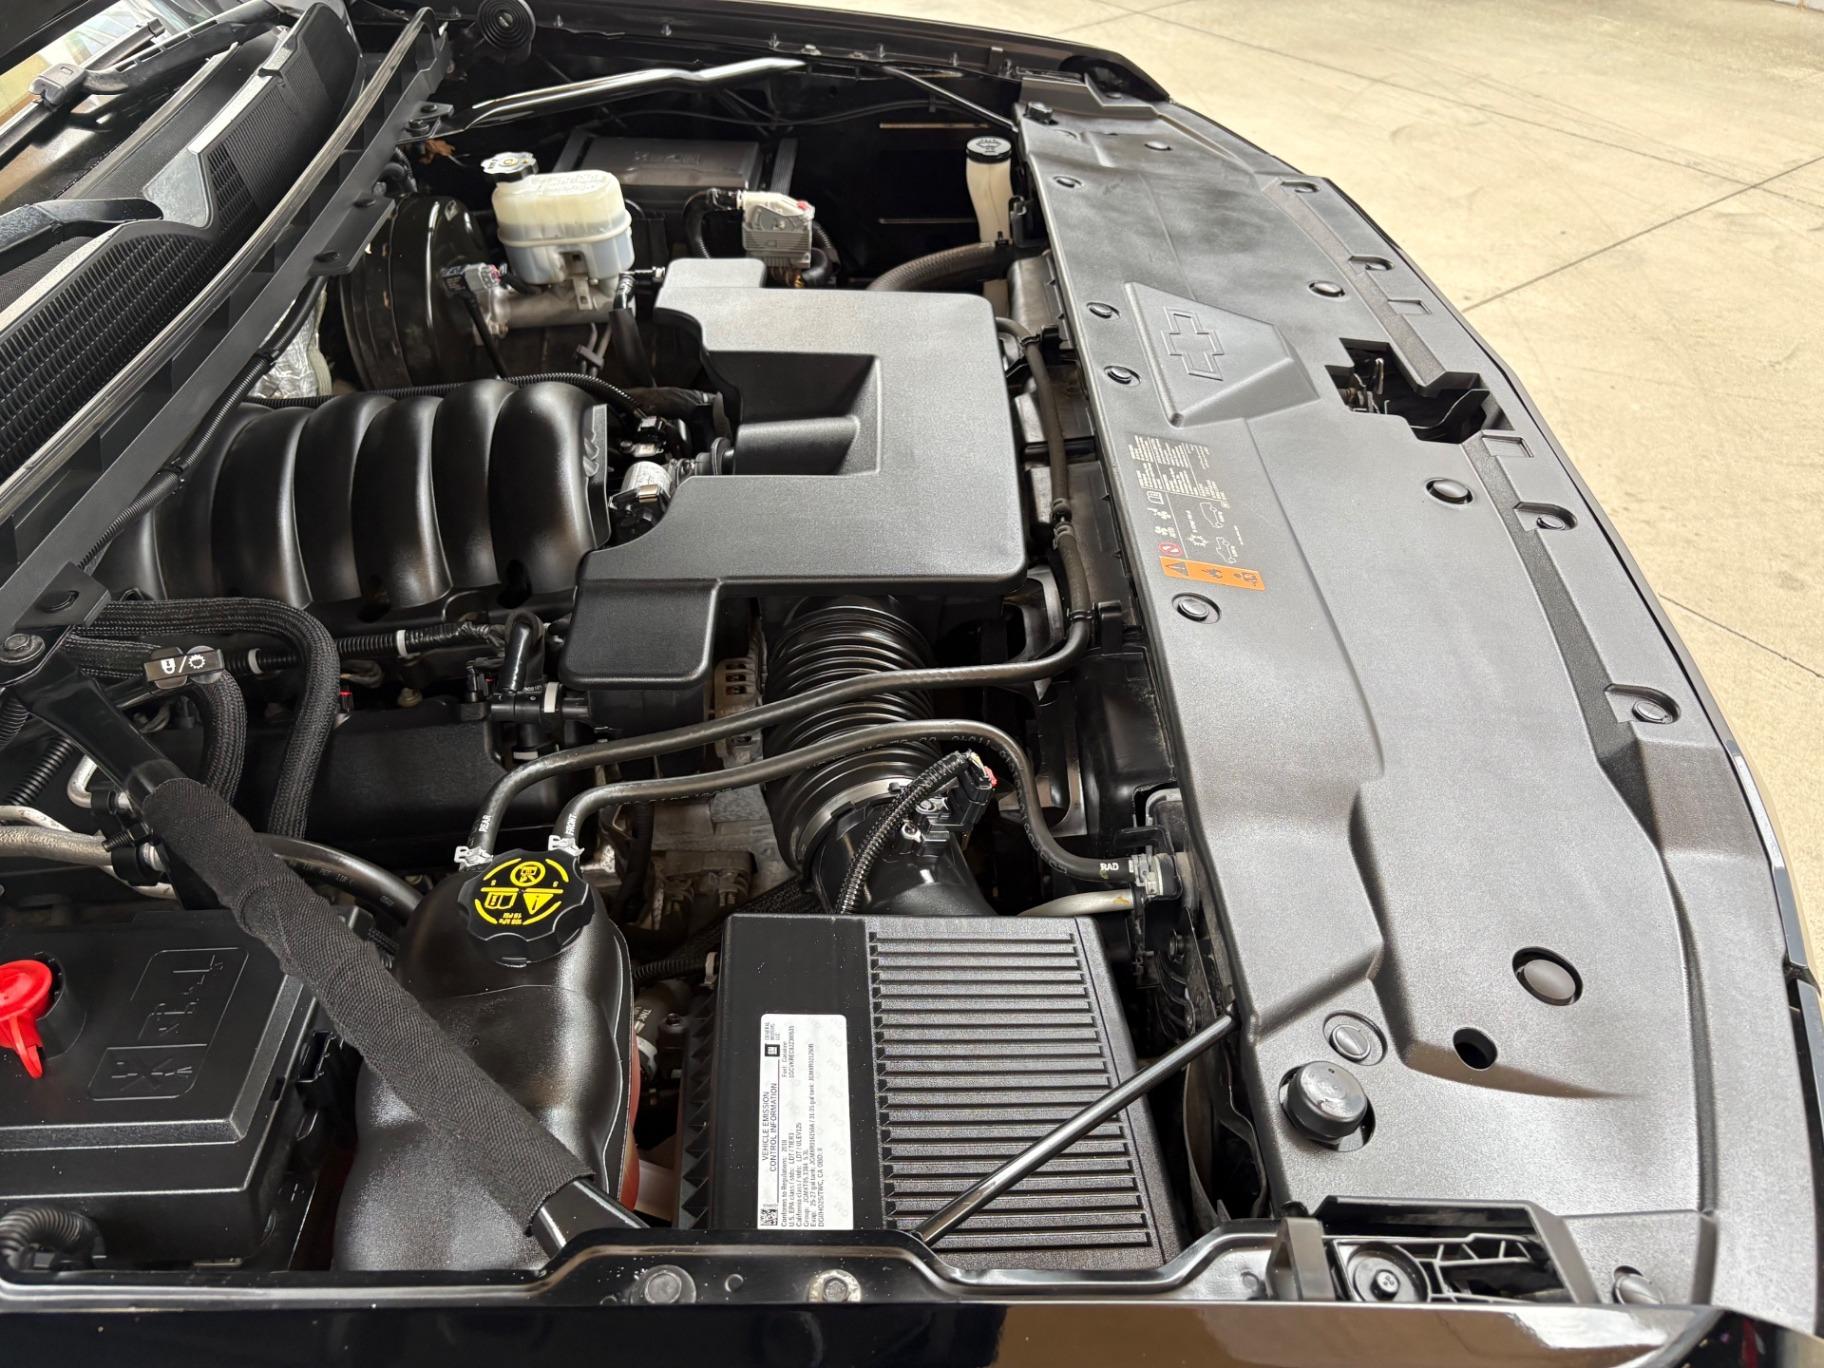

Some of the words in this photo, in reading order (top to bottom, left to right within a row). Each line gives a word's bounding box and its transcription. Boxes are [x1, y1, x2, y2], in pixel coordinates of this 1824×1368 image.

[565, 813, 577, 836] FRONT
[1099, 862, 1119, 871] RAD
[818, 1169, 823, 1178] CA
